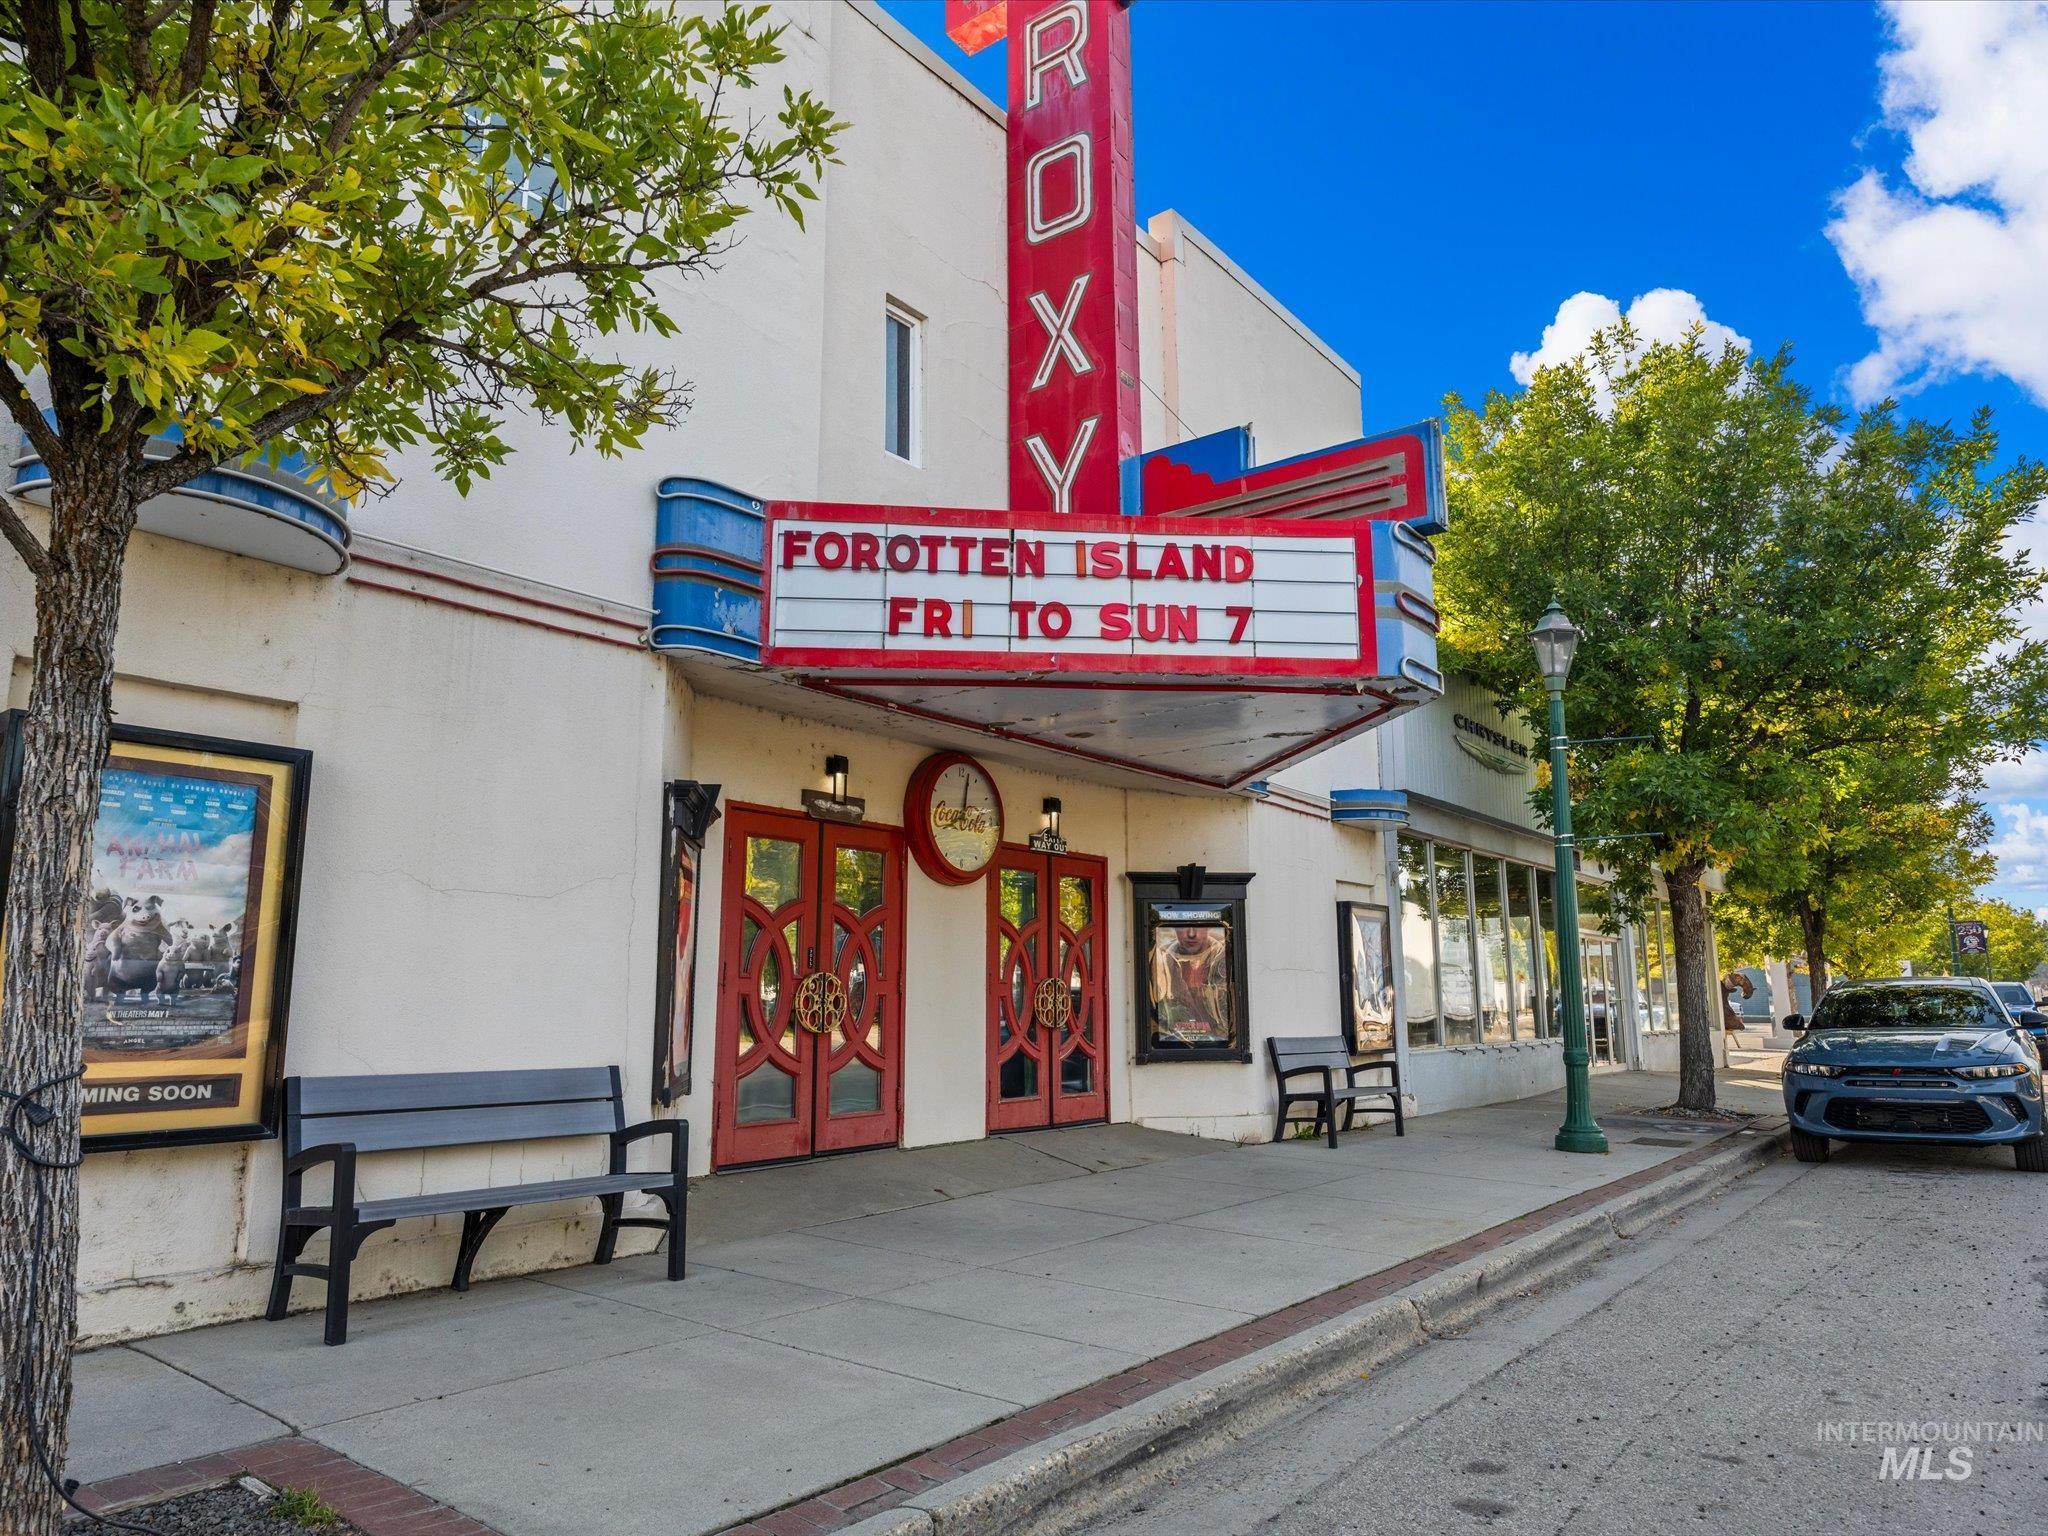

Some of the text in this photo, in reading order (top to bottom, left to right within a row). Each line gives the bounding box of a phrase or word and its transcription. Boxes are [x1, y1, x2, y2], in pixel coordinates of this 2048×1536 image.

[1024, 0, 1101, 513] ROXY
[783, 530, 1254, 583] FOROTTEN ISLAND
[888, 597, 1253, 643] FRI TO SUN 7
[1453, 713, 1528, 758] CHRYSLER
[1034, 840, 1051, 850] WAY
[117, 1010, 148, 1018] THEATERS
[147, 1010, 164, 1018] MAY
[164, 1010, 169, 1018] 1
[80, 1084, 212, 1103] MING SOON
